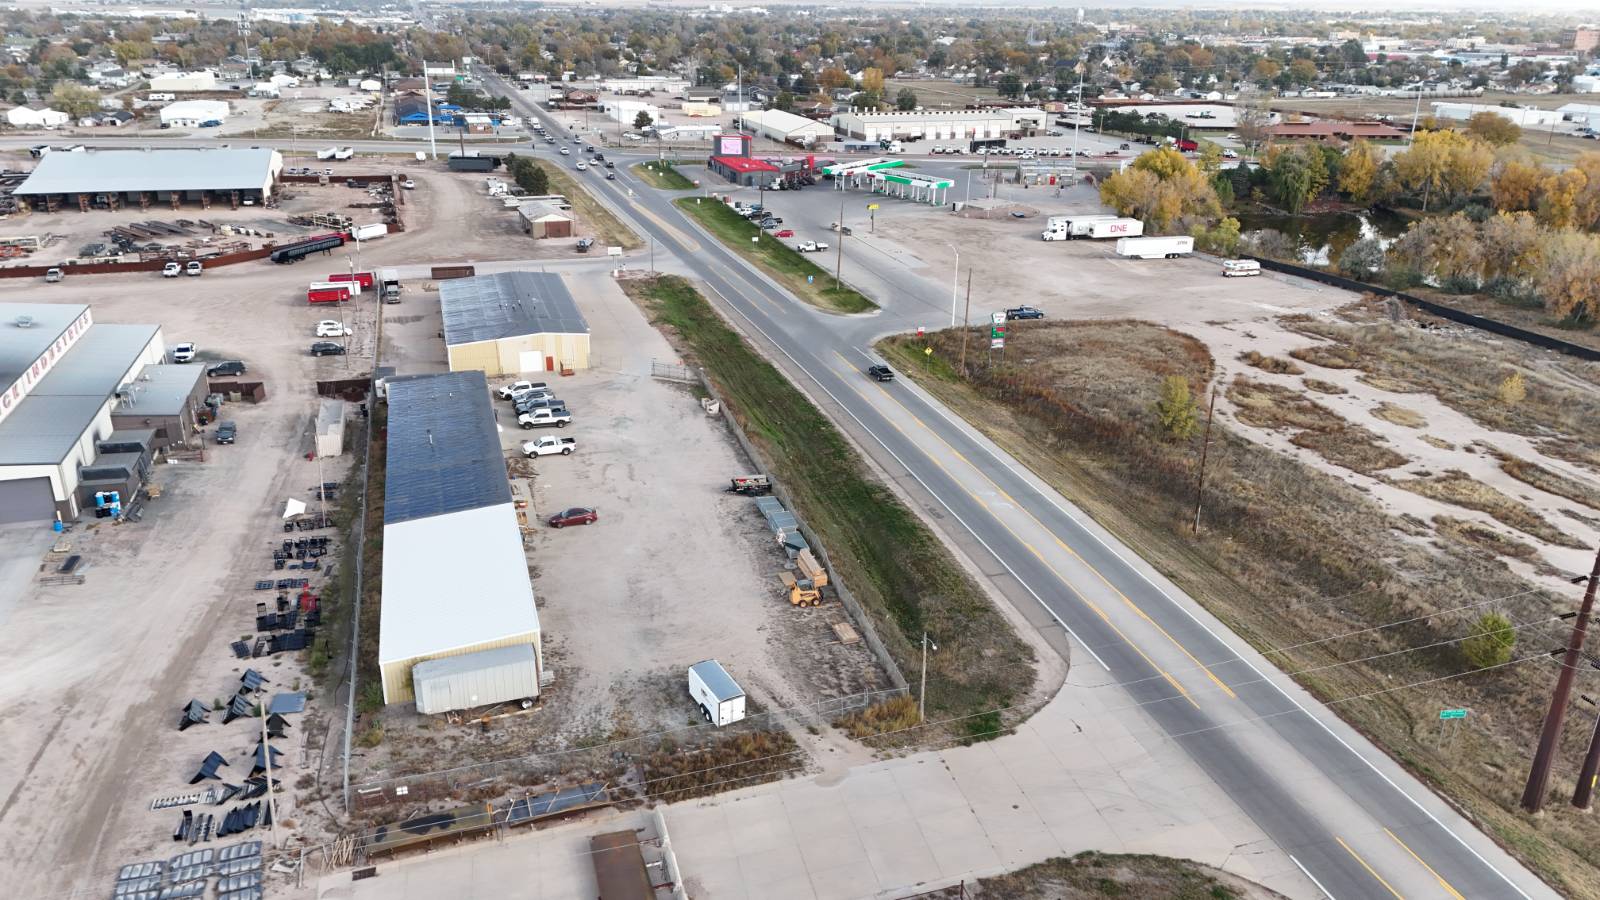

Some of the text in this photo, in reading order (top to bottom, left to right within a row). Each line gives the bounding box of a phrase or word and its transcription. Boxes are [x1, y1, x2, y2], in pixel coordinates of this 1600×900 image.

[1110, 224, 1127, 232] ONE
[0, 313, 89, 413] CK INDUSTRIES
